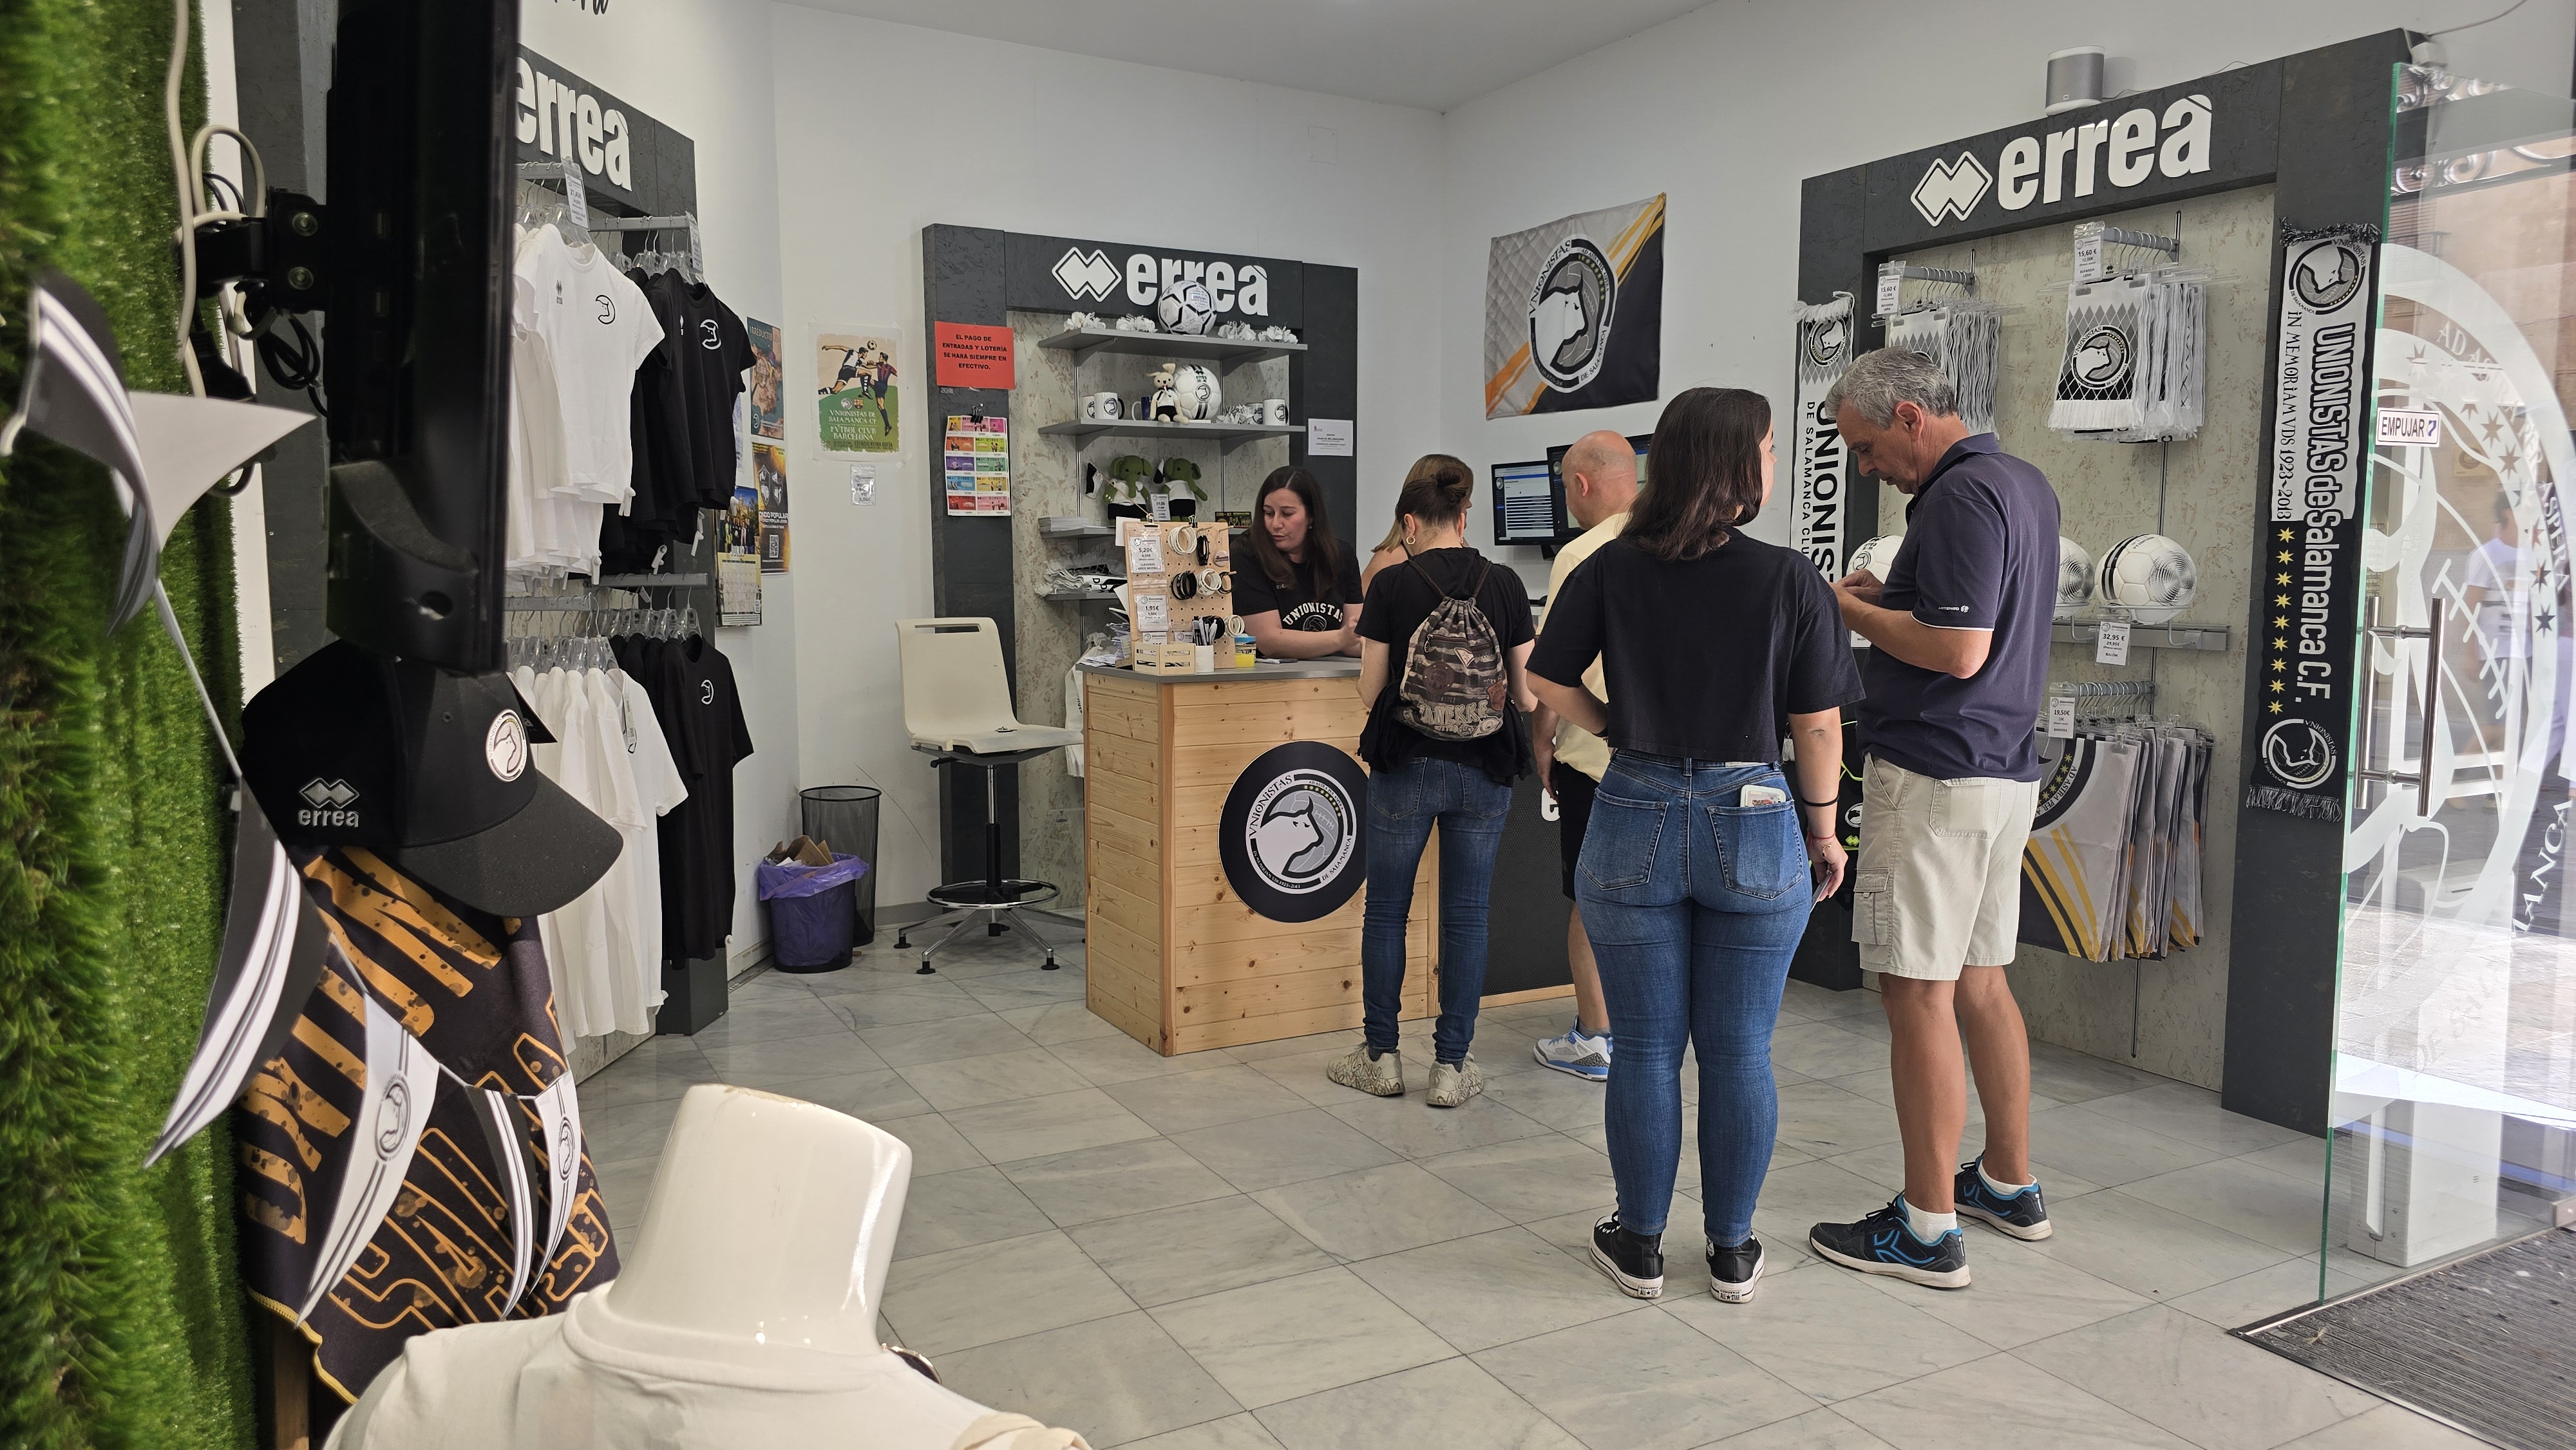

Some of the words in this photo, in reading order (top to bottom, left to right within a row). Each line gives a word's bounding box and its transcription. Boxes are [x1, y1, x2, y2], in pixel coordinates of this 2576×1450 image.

[829, 416, 867, 424] SALAMANCA
[1806, 401, 1815, 420] DE
[833, 432, 874, 440] BARCELONA
[2280, 417, 2297, 446] VDS
[2381, 417, 2425, 438] EMPUJAR
[1802, 427, 1814, 520] SALAMANCA
[1282, 602, 1343, 625] UNIONISTAS
[1421, 700, 1488, 726] ANEKKE
[2069, 766, 2078, 778] AD
[2053, 778, 2071, 801] ASTRA
[2041, 800, 2055, 811] PER
[1329, 838, 1352, 875] SALAMANCA
